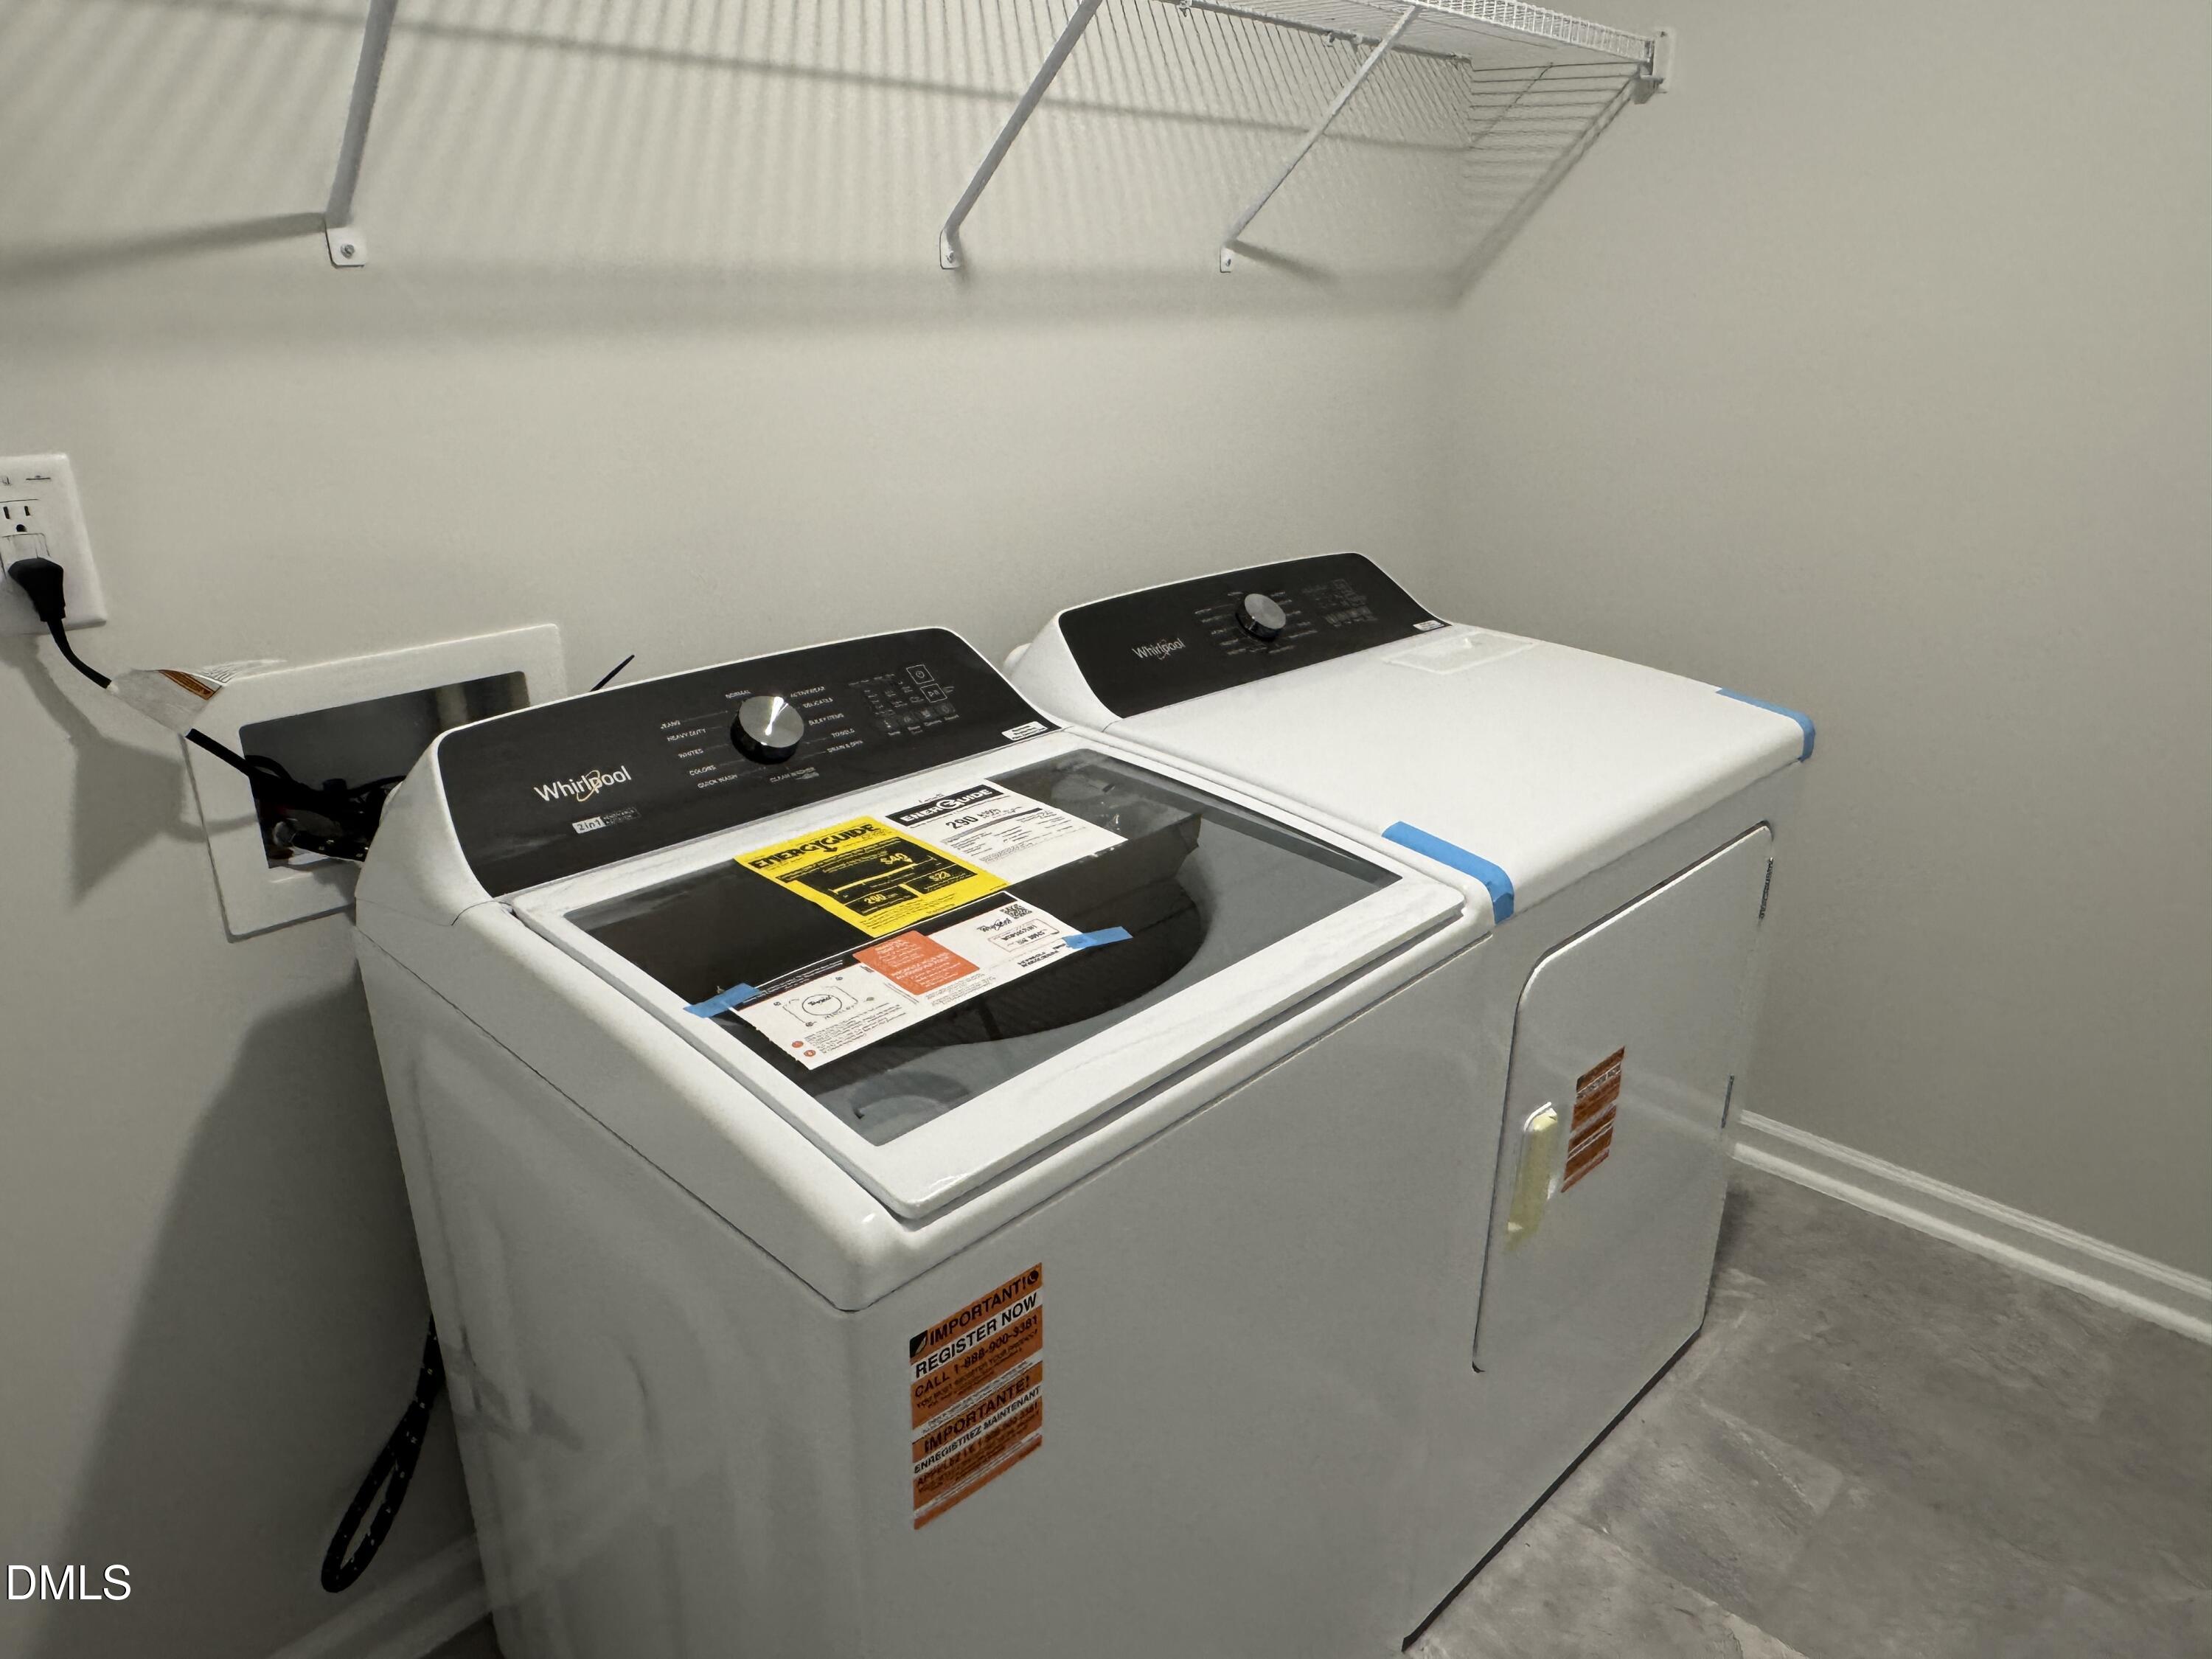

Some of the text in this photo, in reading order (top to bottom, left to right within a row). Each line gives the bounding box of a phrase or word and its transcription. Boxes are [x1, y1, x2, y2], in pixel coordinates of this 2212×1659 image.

[1131, 638, 1186, 660] Whirlpool
[533, 765, 632, 801] Whirlpool
[945, 815, 978, 830] 290
[748, 824, 880, 869] ENERGYGUIDE
[930, 1277, 1026, 1346] IMPORTANT!
[916, 1318, 997, 1378] REGISTER
[1001, 1292, 1037, 1326] NOW
[915, 1371, 950, 1398] CALL
[914, 1425, 983, 1474] ENREGISTREZ
[983, 1385, 1041, 1431] MAINTENANT
